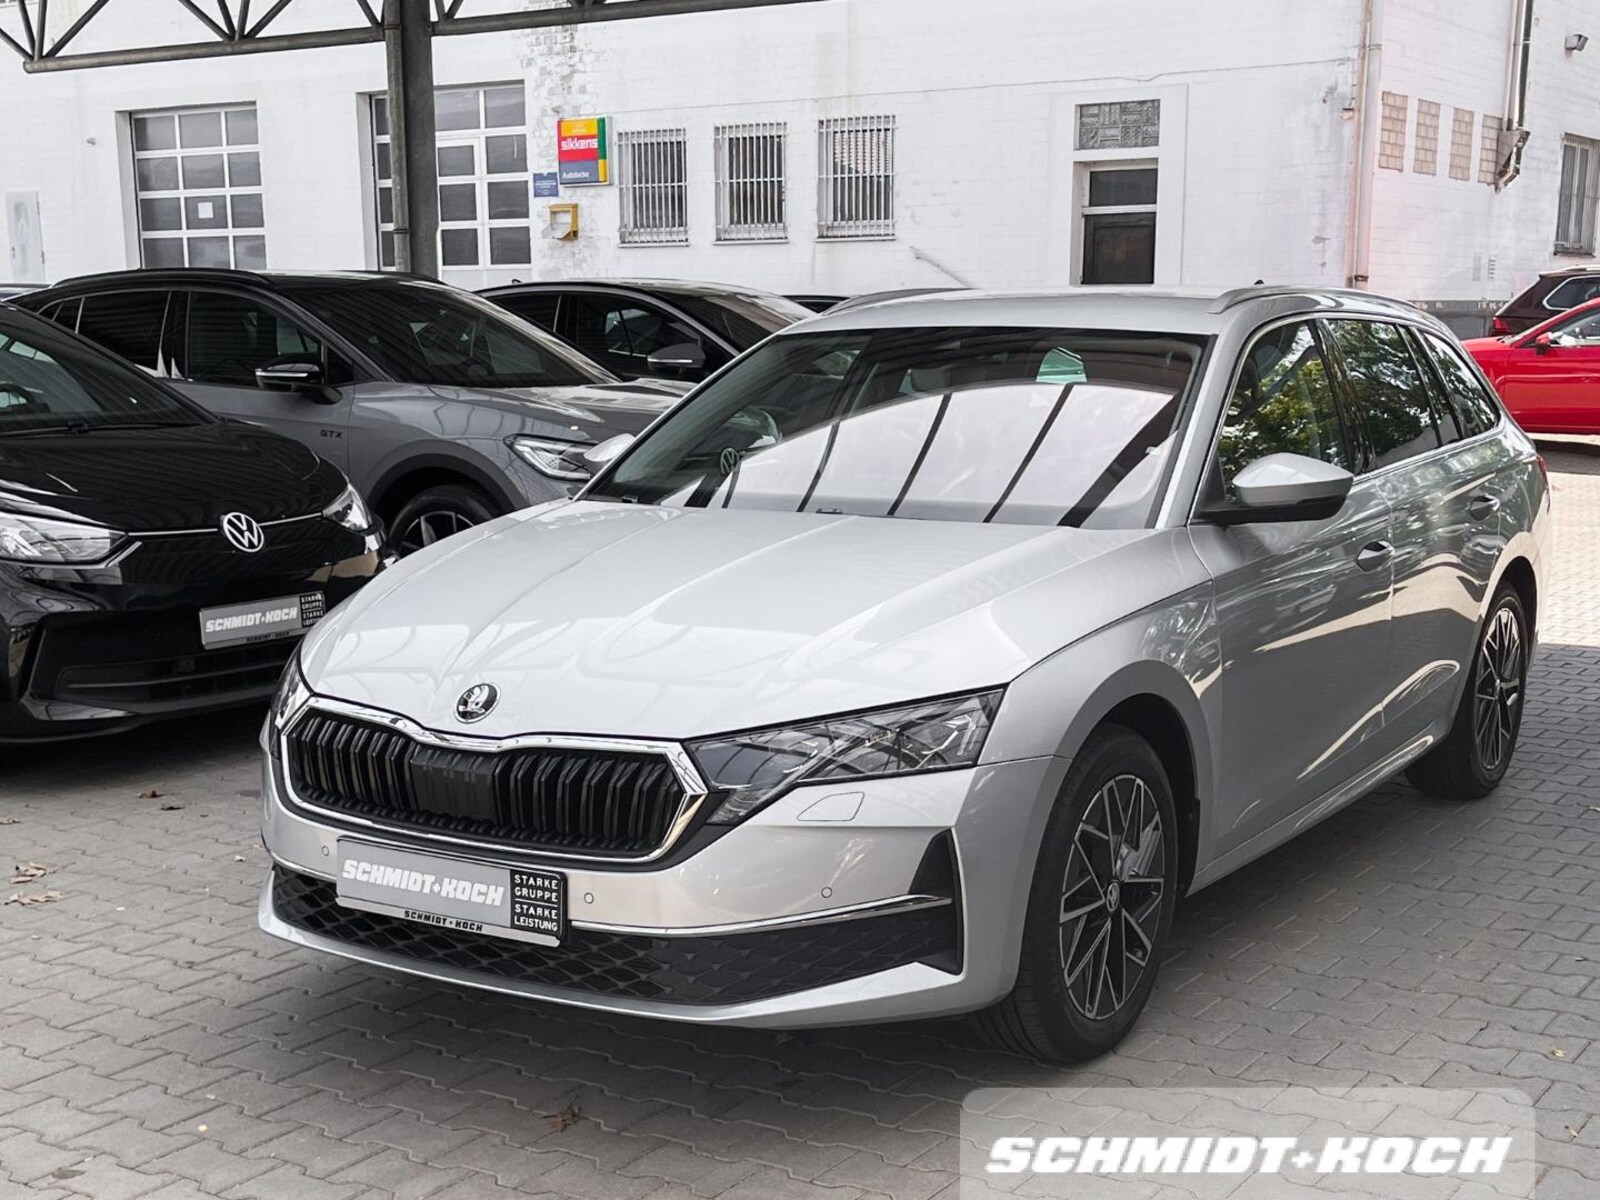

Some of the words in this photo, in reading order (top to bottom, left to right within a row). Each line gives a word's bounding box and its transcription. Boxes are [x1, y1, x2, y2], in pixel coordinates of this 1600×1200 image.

[320, 429, 343, 439] GTX
[514, 874, 558, 890] STARKE
[514, 886, 558, 902] GRUPPE
[514, 903, 558, 919] STARKE
[514, 915, 558, 931] LEISTUNG
